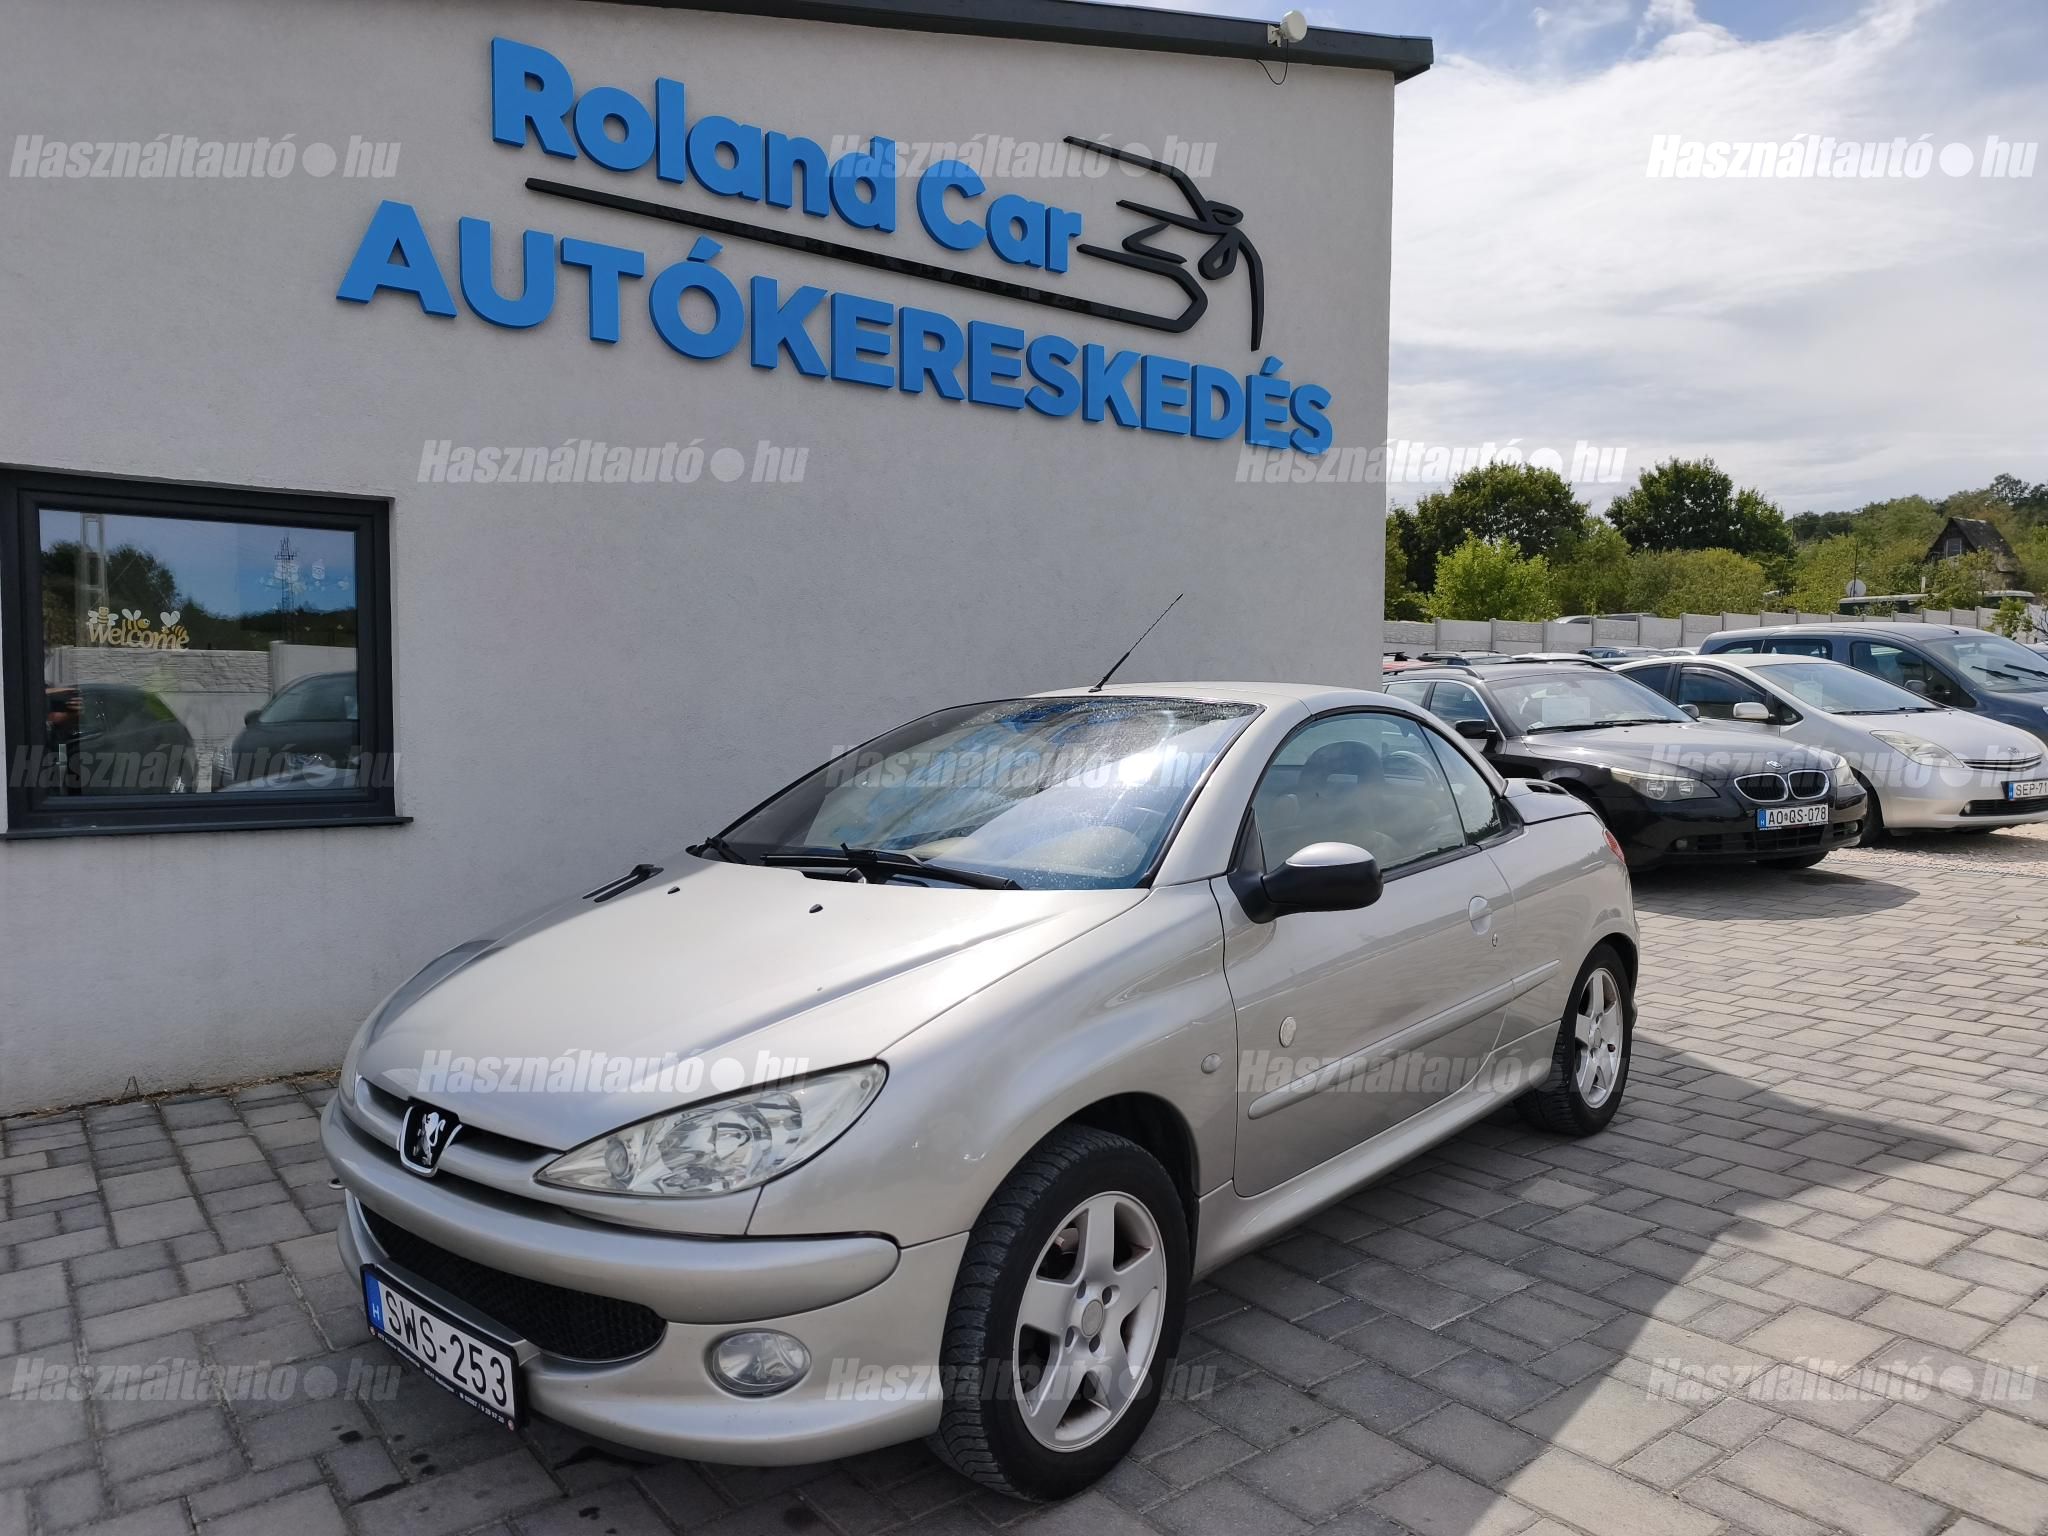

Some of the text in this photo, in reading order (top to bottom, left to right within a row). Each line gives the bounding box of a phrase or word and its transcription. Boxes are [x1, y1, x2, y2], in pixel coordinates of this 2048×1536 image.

[491, 36, 1082, 274] Roland Car
[336, 199, 1333, 455] AUTÓKERESKEDÉS
[86, 618, 190, 650] Welcome
[1768, 810, 1783, 825] AO
[1789, 806, 1827, 823] QS-078
[372, 1303, 381, 1321] H
[385, 1290, 507, 1407] SWS-253
